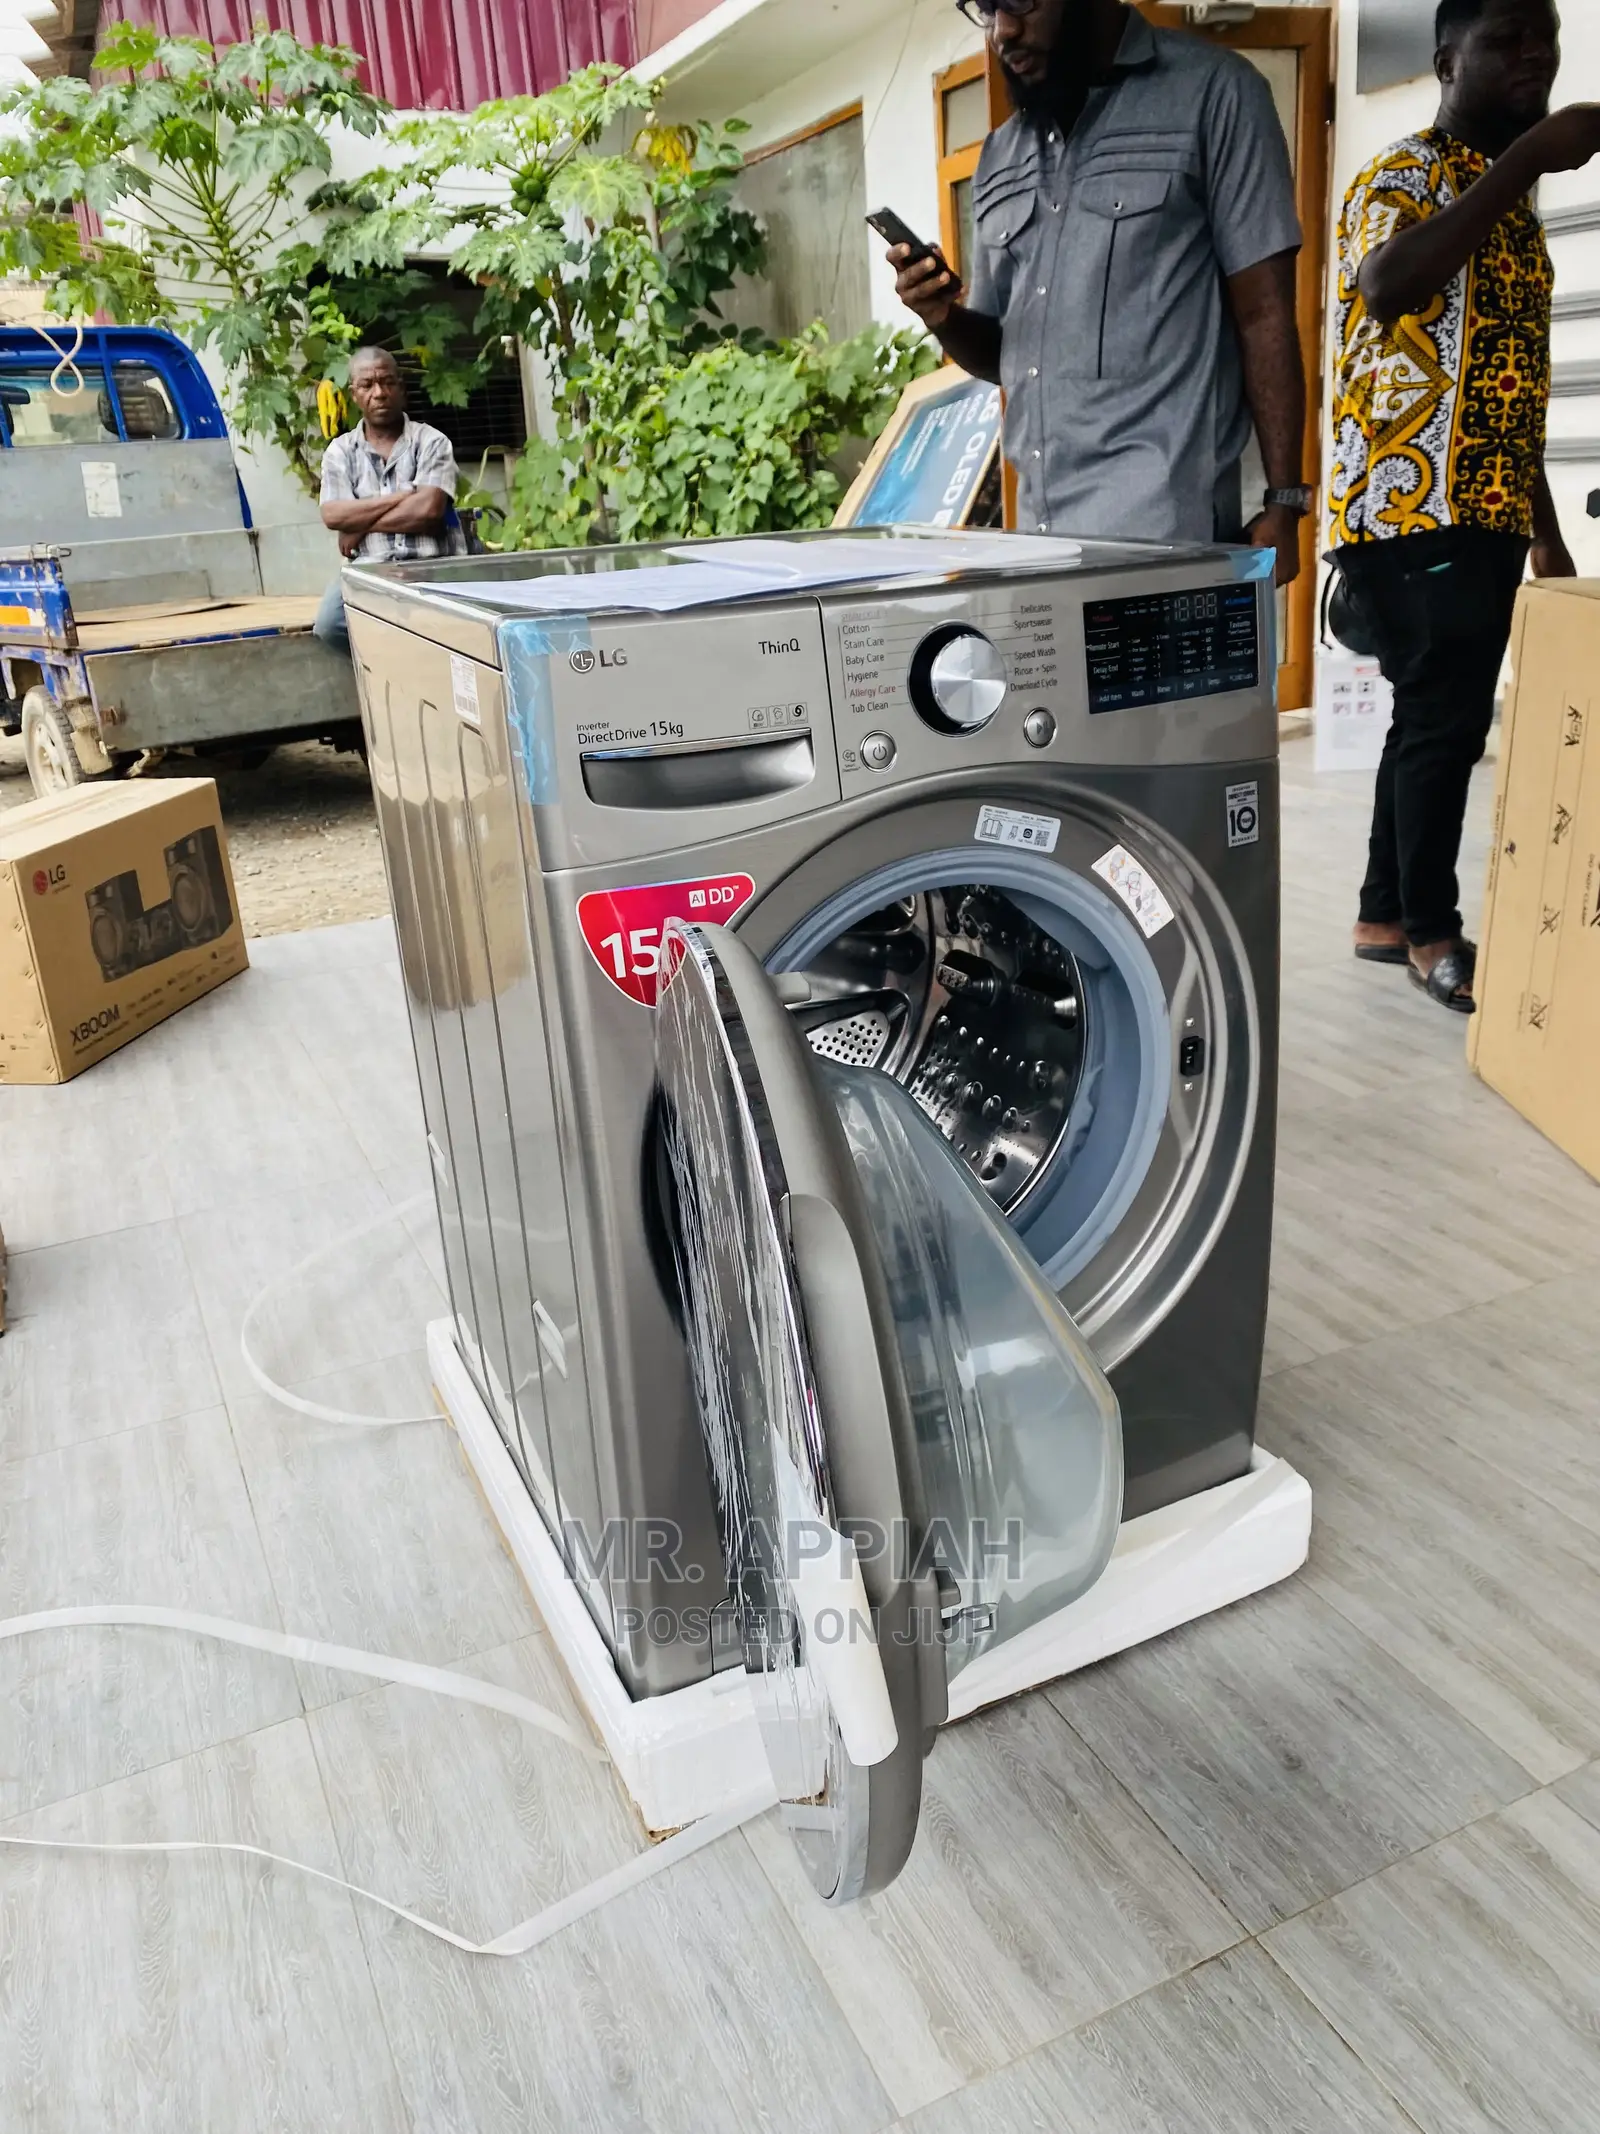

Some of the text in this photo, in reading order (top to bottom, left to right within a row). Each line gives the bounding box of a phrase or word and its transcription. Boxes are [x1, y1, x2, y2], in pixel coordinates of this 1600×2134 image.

[942, 430, 986, 505] OLED
[1020, 604, 1053, 614] Delicates
[842, 624, 870, 635] Cotton
[758, 638, 801, 655] ThinQ
[844, 637, 885, 650] Stain Care
[599, 648, 627, 667] LG
[845, 653, 885, 667] Baby Care
[1014, 647, 1056, 661] Speed Wash
[847, 669, 879, 683] Hygiene
[1014, 666, 1033, 677] Rinse
[1041, 663, 1057, 674] Spin
[1010, 677, 1058, 692] Download Cycle
[850, 684, 896, 700] Allergy Care
[851, 701, 889, 714] Tub Clean
[576, 720, 610, 731] Inverter
[1230, 806, 1256, 836] 10
[48, 864, 65, 884] LG
[691, 890, 705, 906] AI
[69, 1004, 121, 1046] XBOOM
